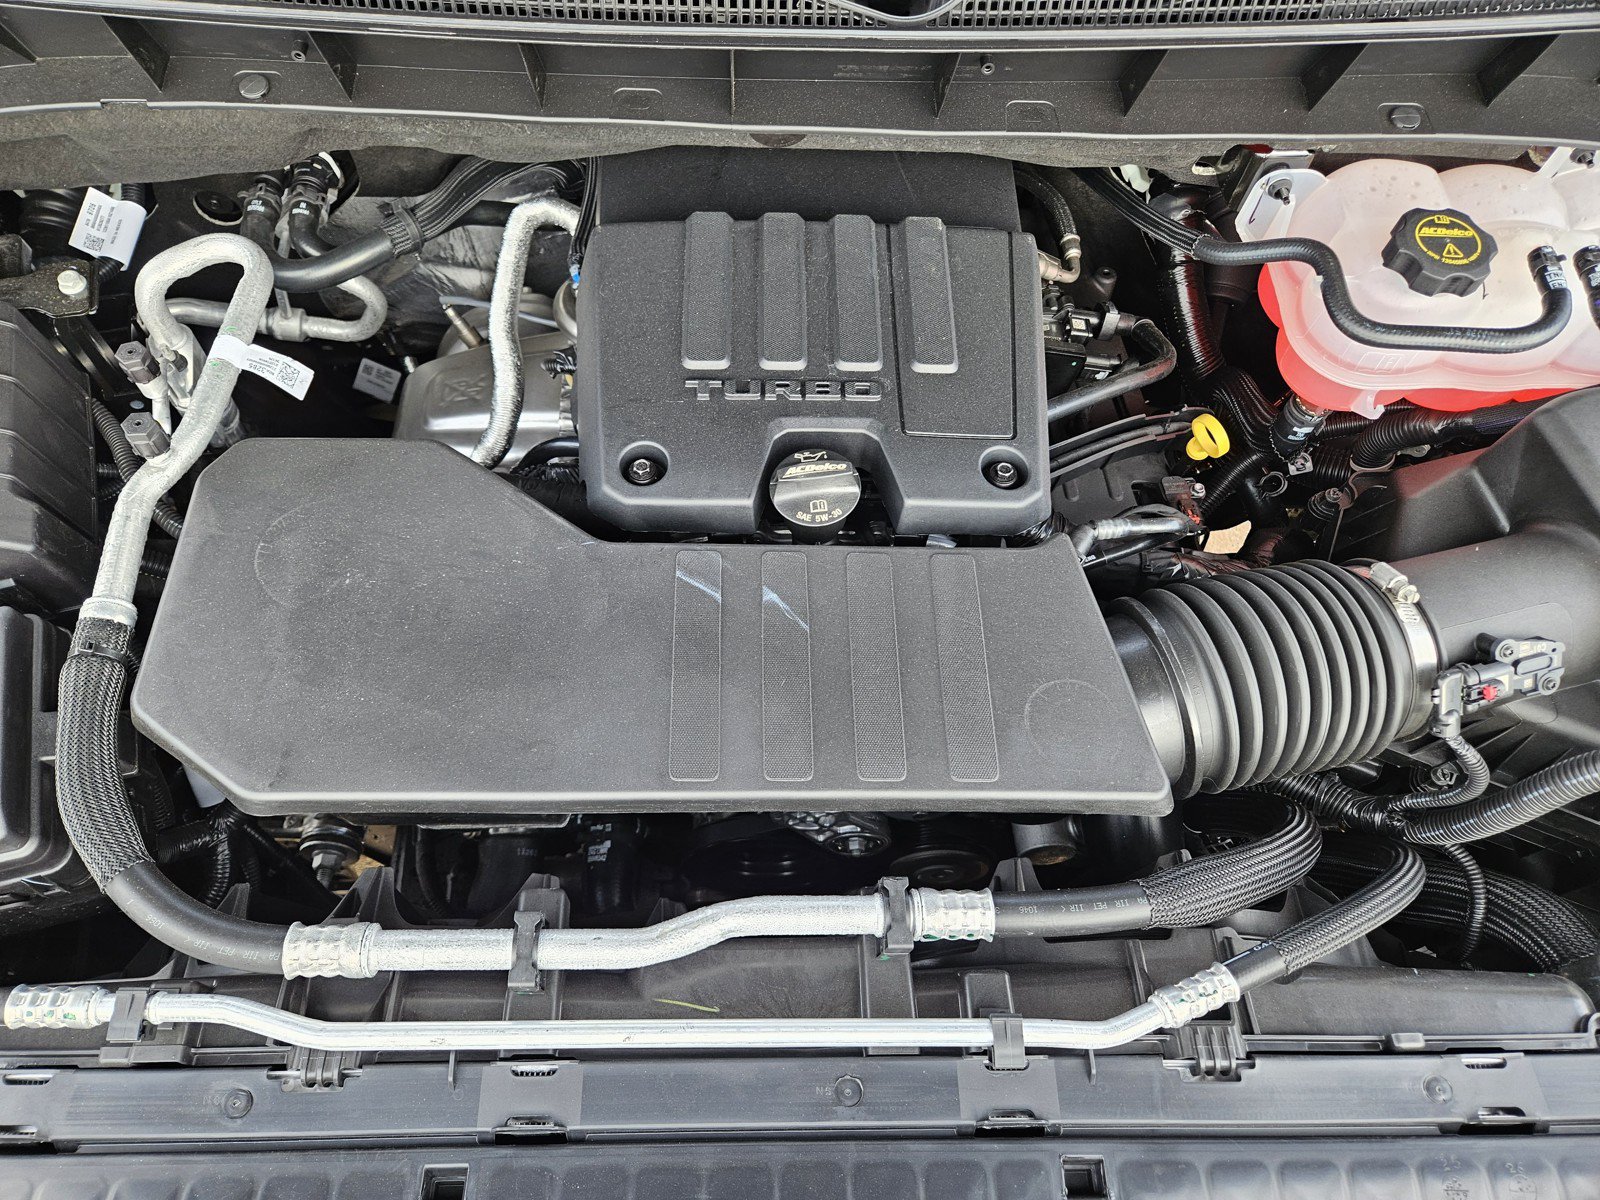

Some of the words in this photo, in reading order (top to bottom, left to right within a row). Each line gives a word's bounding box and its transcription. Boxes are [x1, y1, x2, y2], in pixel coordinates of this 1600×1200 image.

[1419, 226, 1474, 237] ACDelco
[684, 379, 882, 402] TURBO
[783, 463, 848, 477] ACDelco
[796, 511, 812, 522] SAE
[815, 508, 843, 522] 5W-30
[1018, 905, 1038, 914] 1046
[1092, 901, 1107, 910] PET
[217, 945, 236, 956] PET
